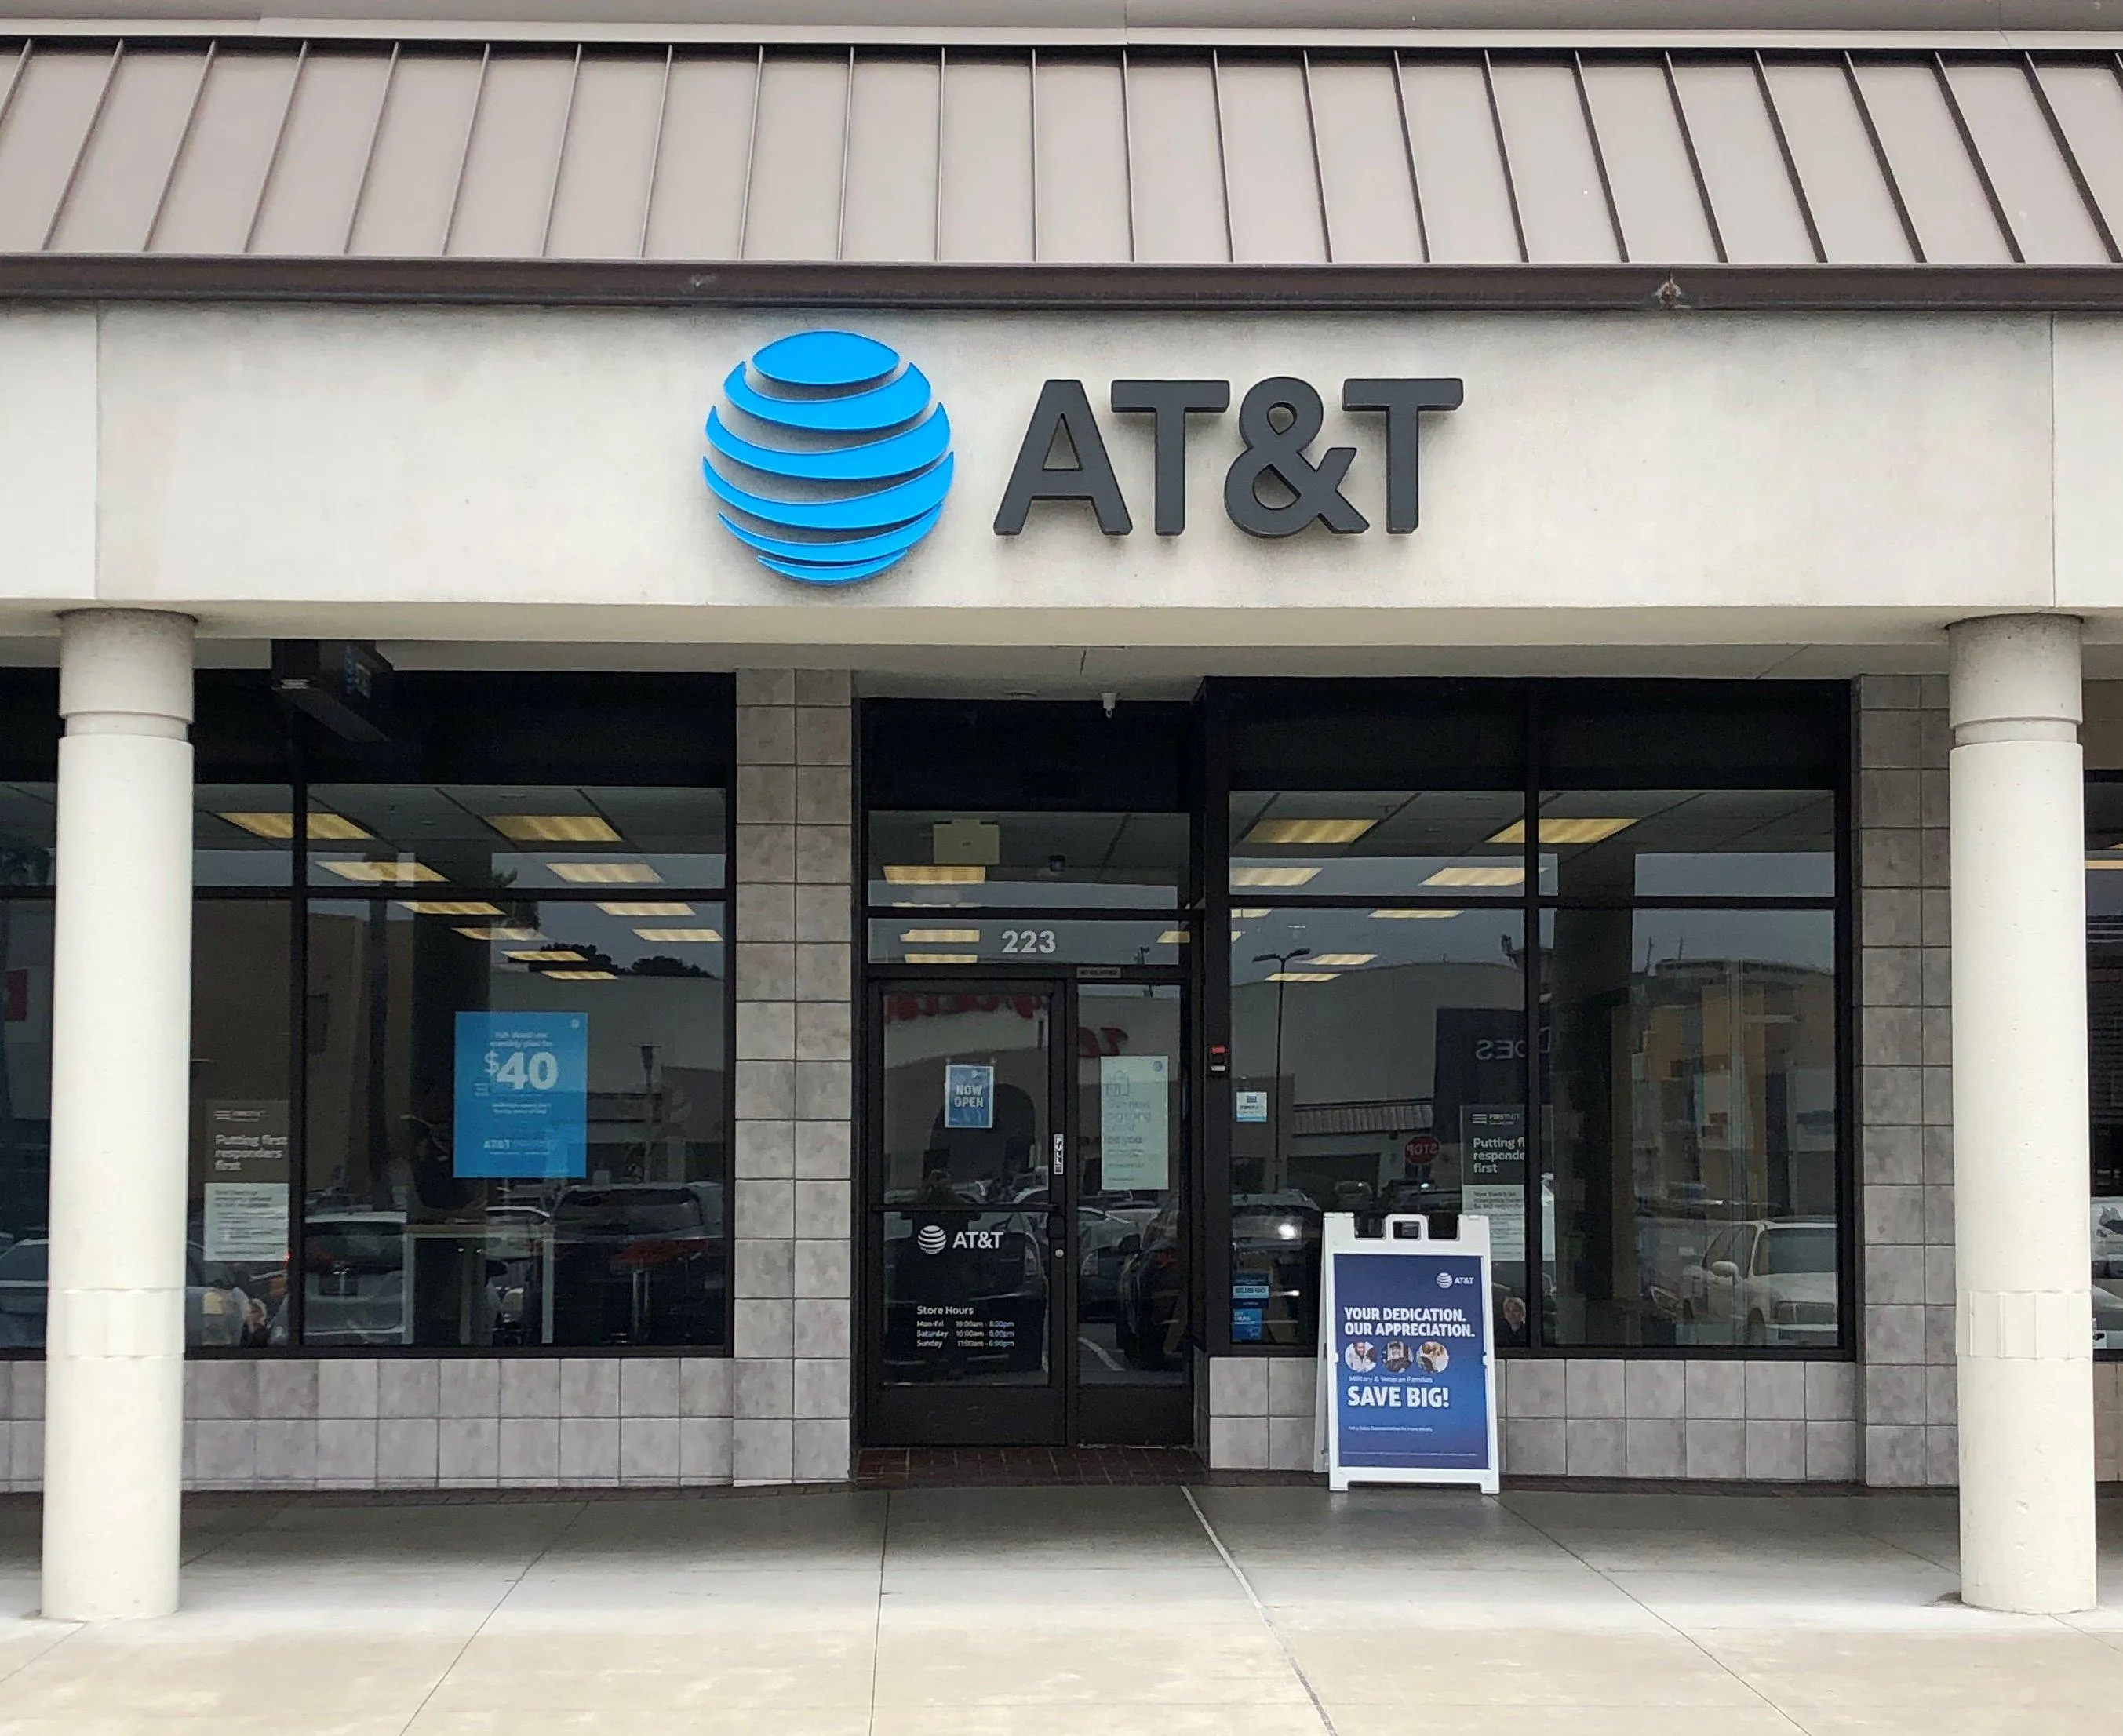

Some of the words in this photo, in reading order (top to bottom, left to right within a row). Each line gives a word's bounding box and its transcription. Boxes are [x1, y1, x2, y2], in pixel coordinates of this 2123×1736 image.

[993, 377, 1463, 538] AT&T
[1002, 930, 1056, 953] 223
[484, 1050, 559, 1090] $40
[956, 1084, 983, 1096] NOW
[954, 1097, 985, 1108] OPEN
[215, 1134, 260, 1147] Putting
[1473, 1137, 1515, 1150] Putting
[1473, 1150, 1525, 1163] responde
[1473, 1163, 1498, 1173] first
[952, 1231, 1004, 1249] AT&T
[916, 1305, 943, 1315] Store
[945, 1306, 974, 1315] Hours
[1344, 1307, 1380, 1320] YOUR
[1382, 1308, 1466, 1322] DEDICATION.
[1344, 1323, 1372, 1335] OUR
[1375, 1323, 1476, 1337] APPRECIATION.
[916, 1340, 942, 1348] Sunday
[1347, 1385, 1402, 1407] SAVE
[1407, 1386, 1450, 1408] BIG!
